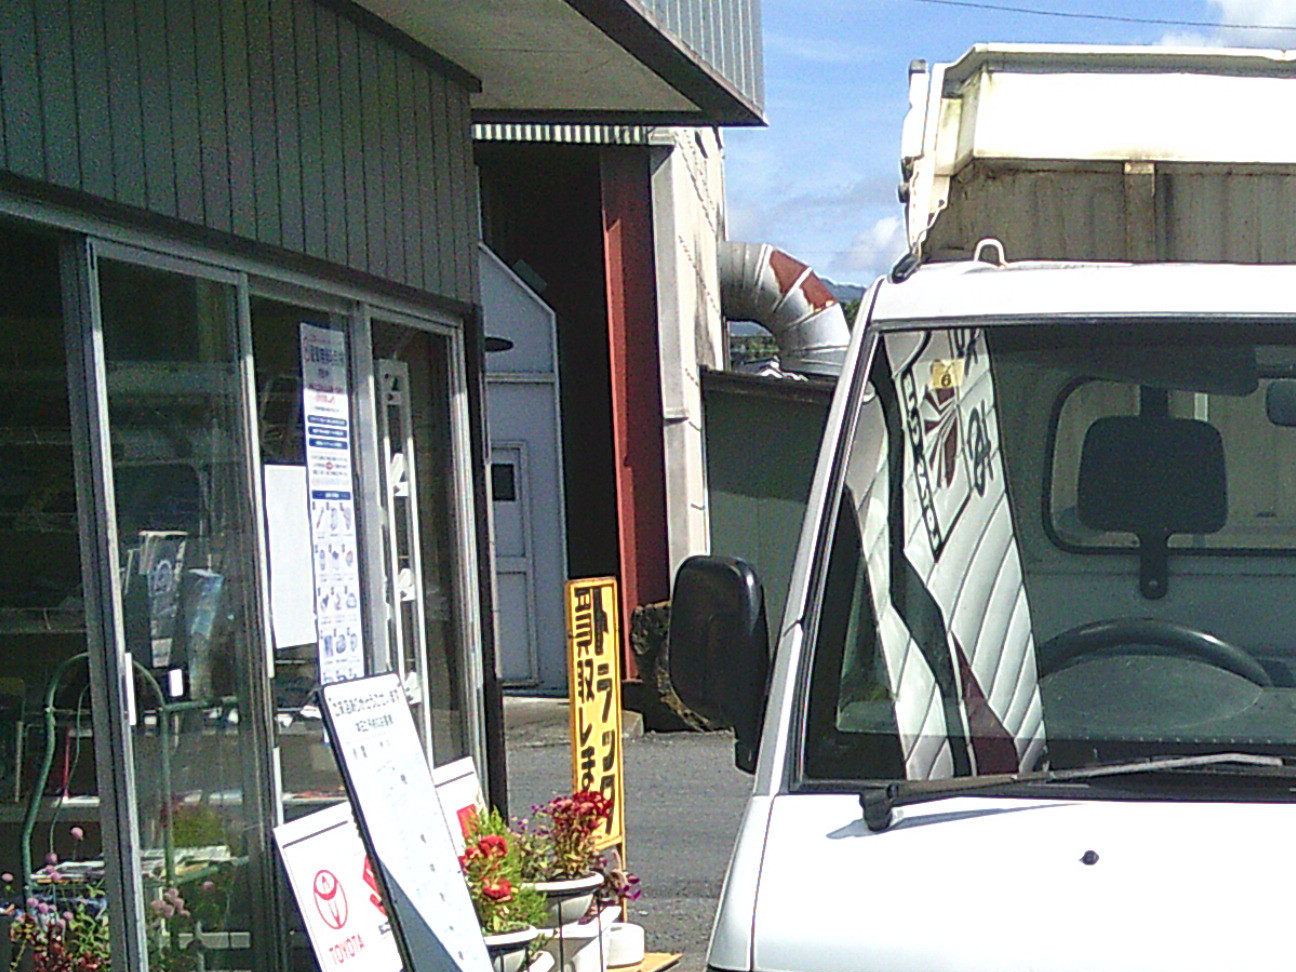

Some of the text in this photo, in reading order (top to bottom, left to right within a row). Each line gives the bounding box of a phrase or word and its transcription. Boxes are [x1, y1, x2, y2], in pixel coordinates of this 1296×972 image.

[592, 587, 615, 835] トラック
[328, 933, 366, 966] TOYOTA
